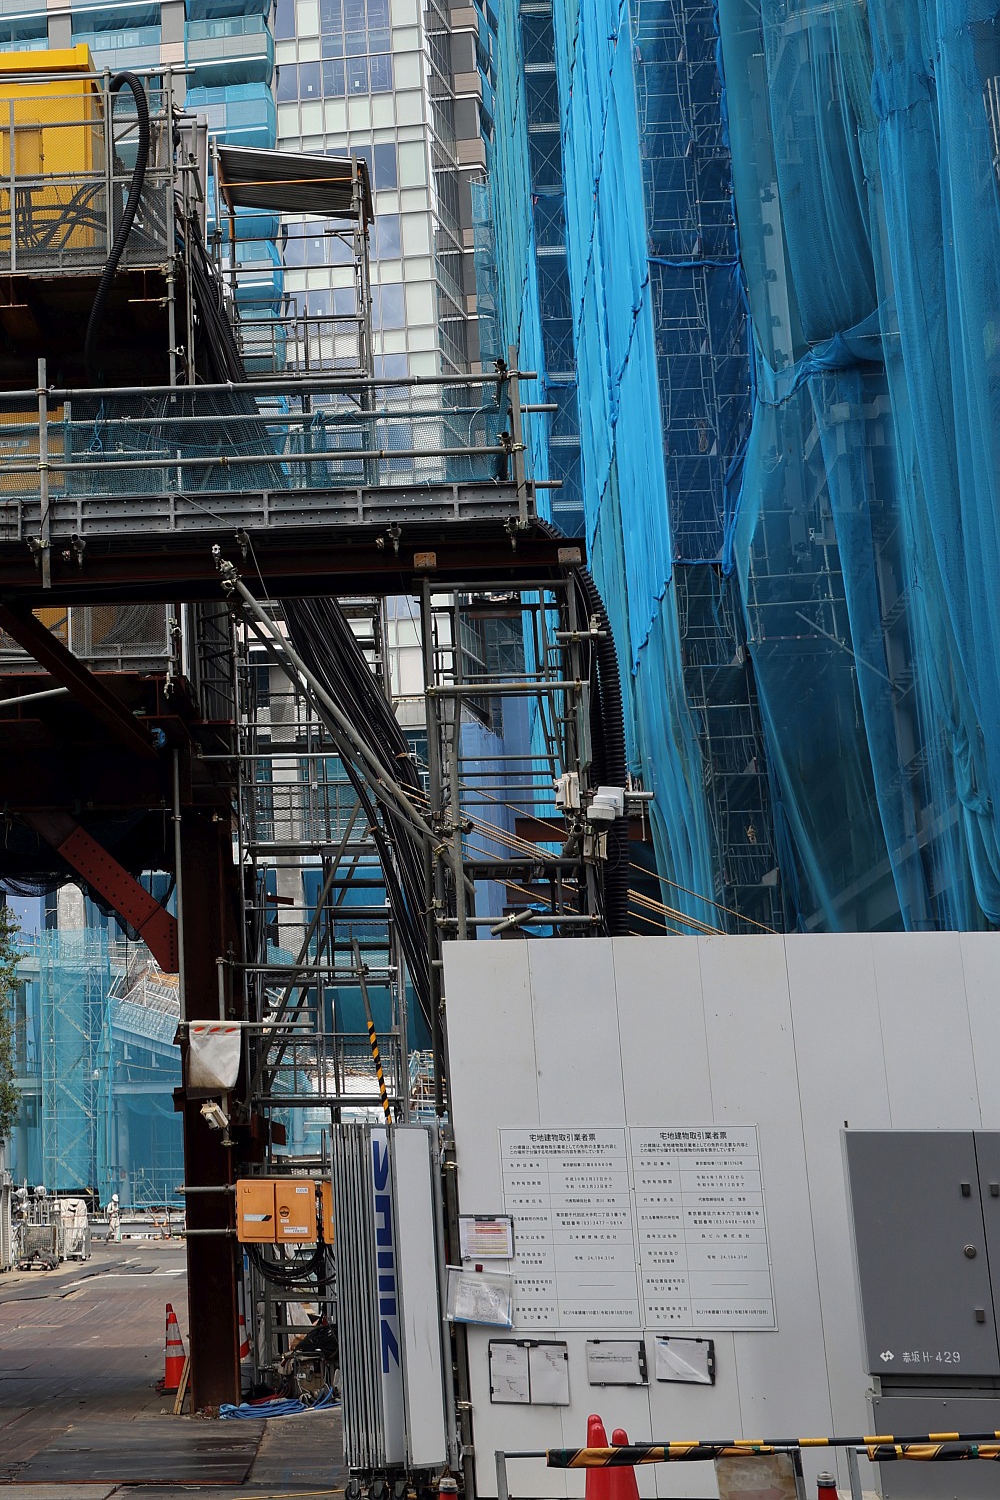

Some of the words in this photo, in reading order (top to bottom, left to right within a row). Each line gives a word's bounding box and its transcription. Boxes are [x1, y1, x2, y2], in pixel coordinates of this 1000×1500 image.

[528, 1134, 596, 1142] 宅地建物取引業者票
[660, 1132, 728, 1140] 宅地建物取引業者票
